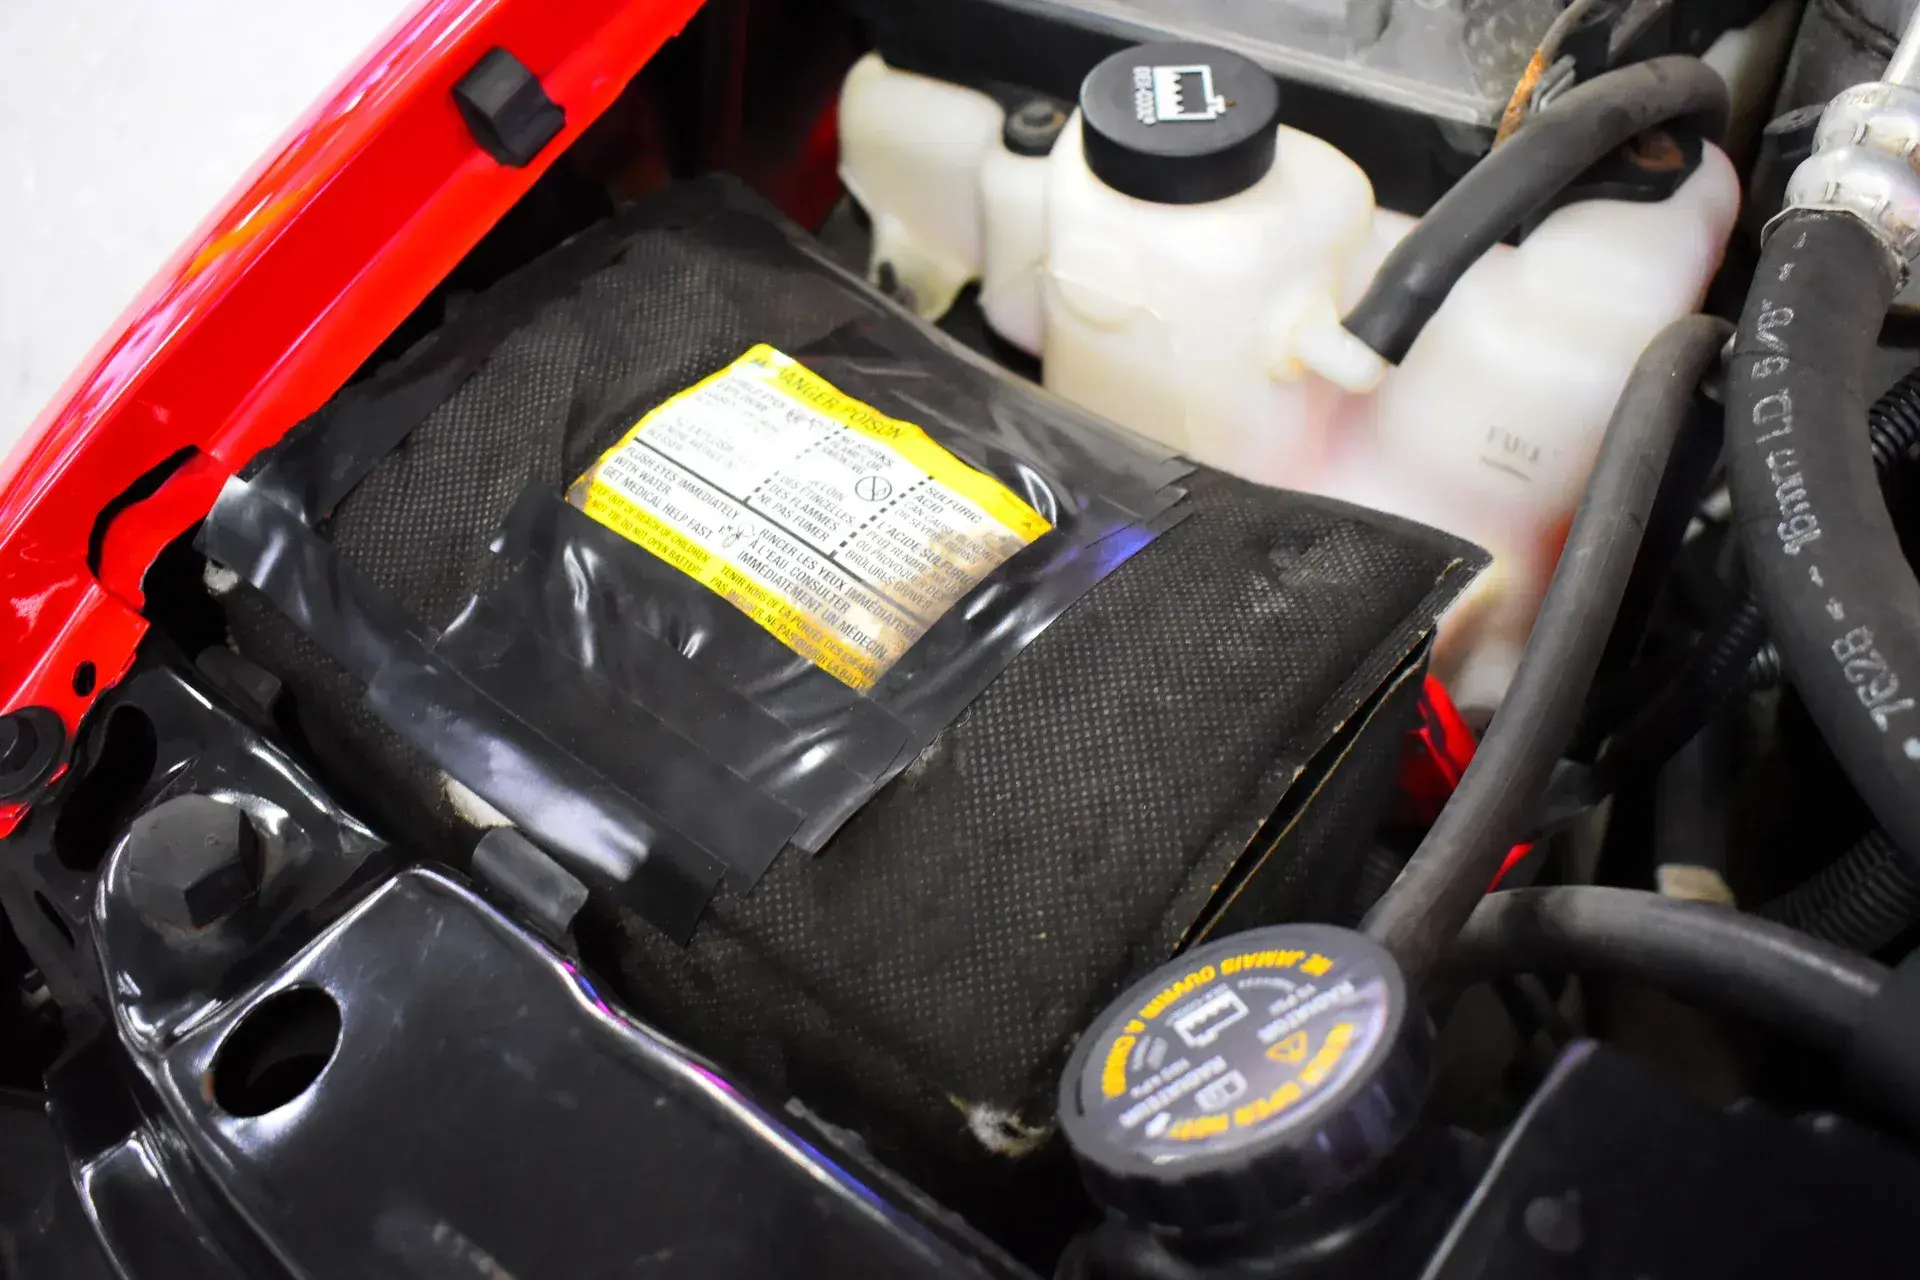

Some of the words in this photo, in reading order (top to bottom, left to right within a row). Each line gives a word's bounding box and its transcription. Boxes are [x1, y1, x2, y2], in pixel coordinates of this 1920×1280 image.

[777, 368, 840, 410] ANGER
[838, 405, 904, 439] POISON
[614, 455, 639, 474] WITH
[603, 465, 624, 481] GET
[621, 476, 663, 508] MEDICAL
[661, 503, 688, 523] HELP
[624, 446, 655, 467] FLUSH
[653, 463, 679, 481] EYES
[677, 477, 739, 519] IMMEDIATELY
[768, 483, 792, 499] DES
[779, 475, 802, 490] DES
[894, 508, 910, 520] OR
[904, 500, 925, 516] CAN
[913, 493, 943, 514] ACID
[925, 485, 982, 522] SULFURIC
[1766, 448, 1821, 555] 16mm
[758, 493, 773, 505] NE
[772, 501, 794, 518] PAS
[792, 515, 829, 541] FUMER
[647, 535, 669, 553] OPEN
[671, 534, 710, 563] CHILDREN
[855, 539, 872, 552] OU
[877, 520, 922, 553] L'ACIDE
[758, 527, 798, 556] RINCER
[795, 552, 818, 570] LES
[817, 566, 847, 591] YEUX
[709, 576, 728, 592] PAS
[720, 565, 746, 586] TENIR
[736, 549, 822, 613] IMMÉDIATEMENT
[820, 607, 840, 626] UN
[789, 565, 851, 614] CONSULTER
